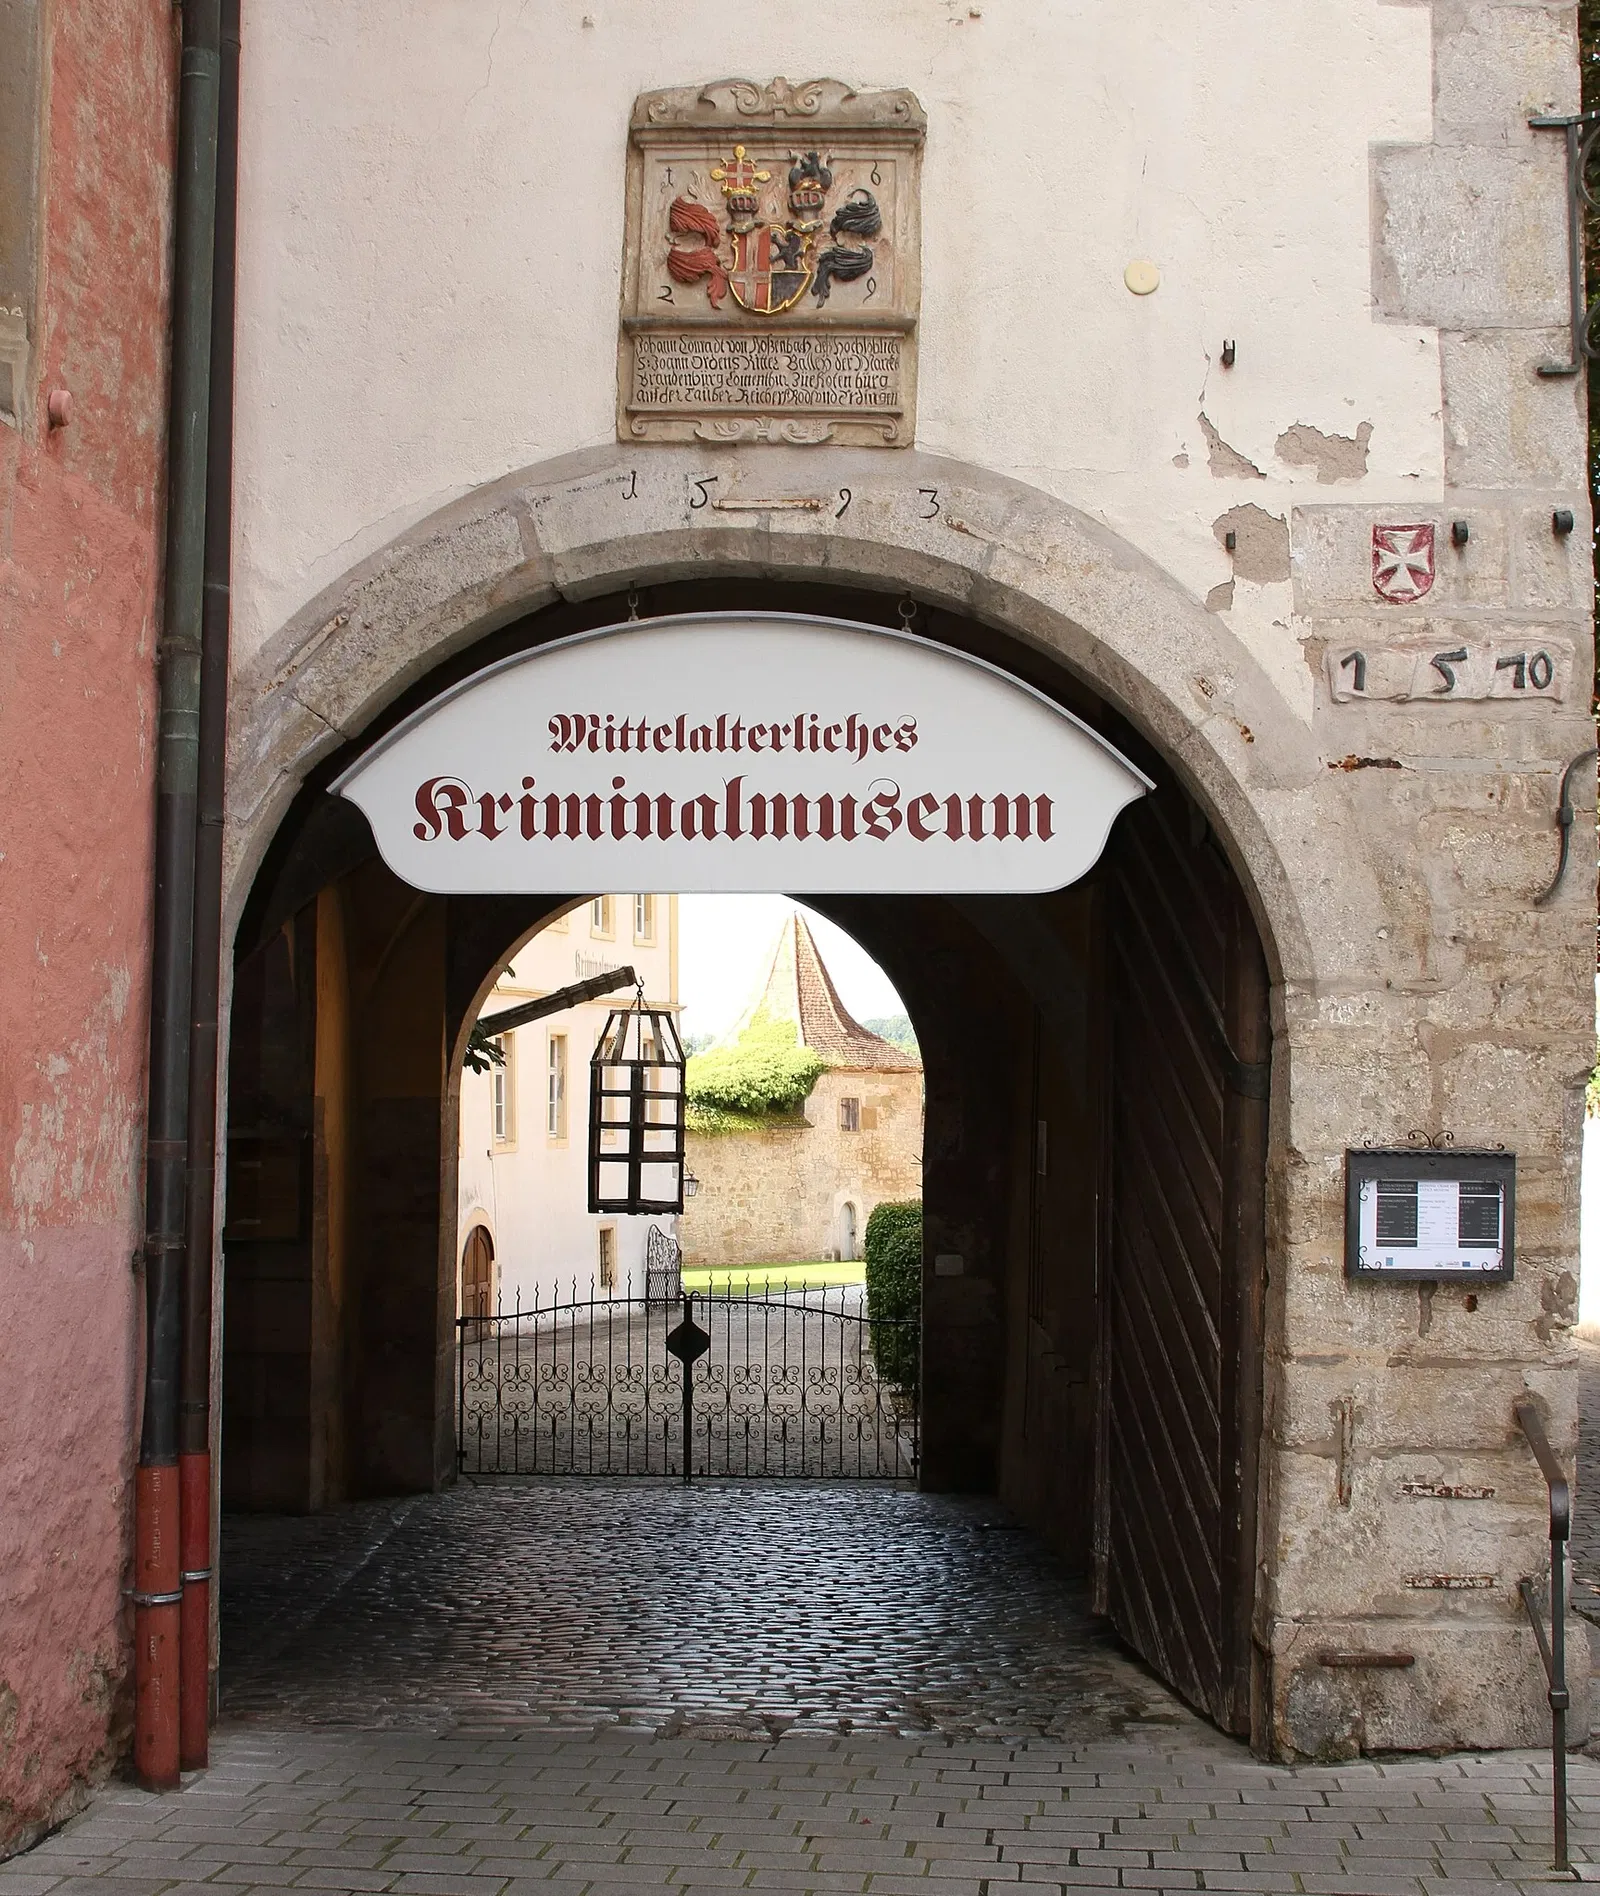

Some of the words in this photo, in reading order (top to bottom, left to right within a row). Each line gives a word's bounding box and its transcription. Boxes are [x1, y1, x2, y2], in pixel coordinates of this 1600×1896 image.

[657, 285, 676, 306] 2
[862, 276, 876, 304] 9
[690, 475, 718, 510] 5
[917, 488, 940, 519] 3
[1340, 650, 1366, 691] 1
[1429, 647, 1468, 693] 5
[547, 711, 919, 766] Mittelalterliches
[412, 772, 1057, 844] Kriminalmuseum
